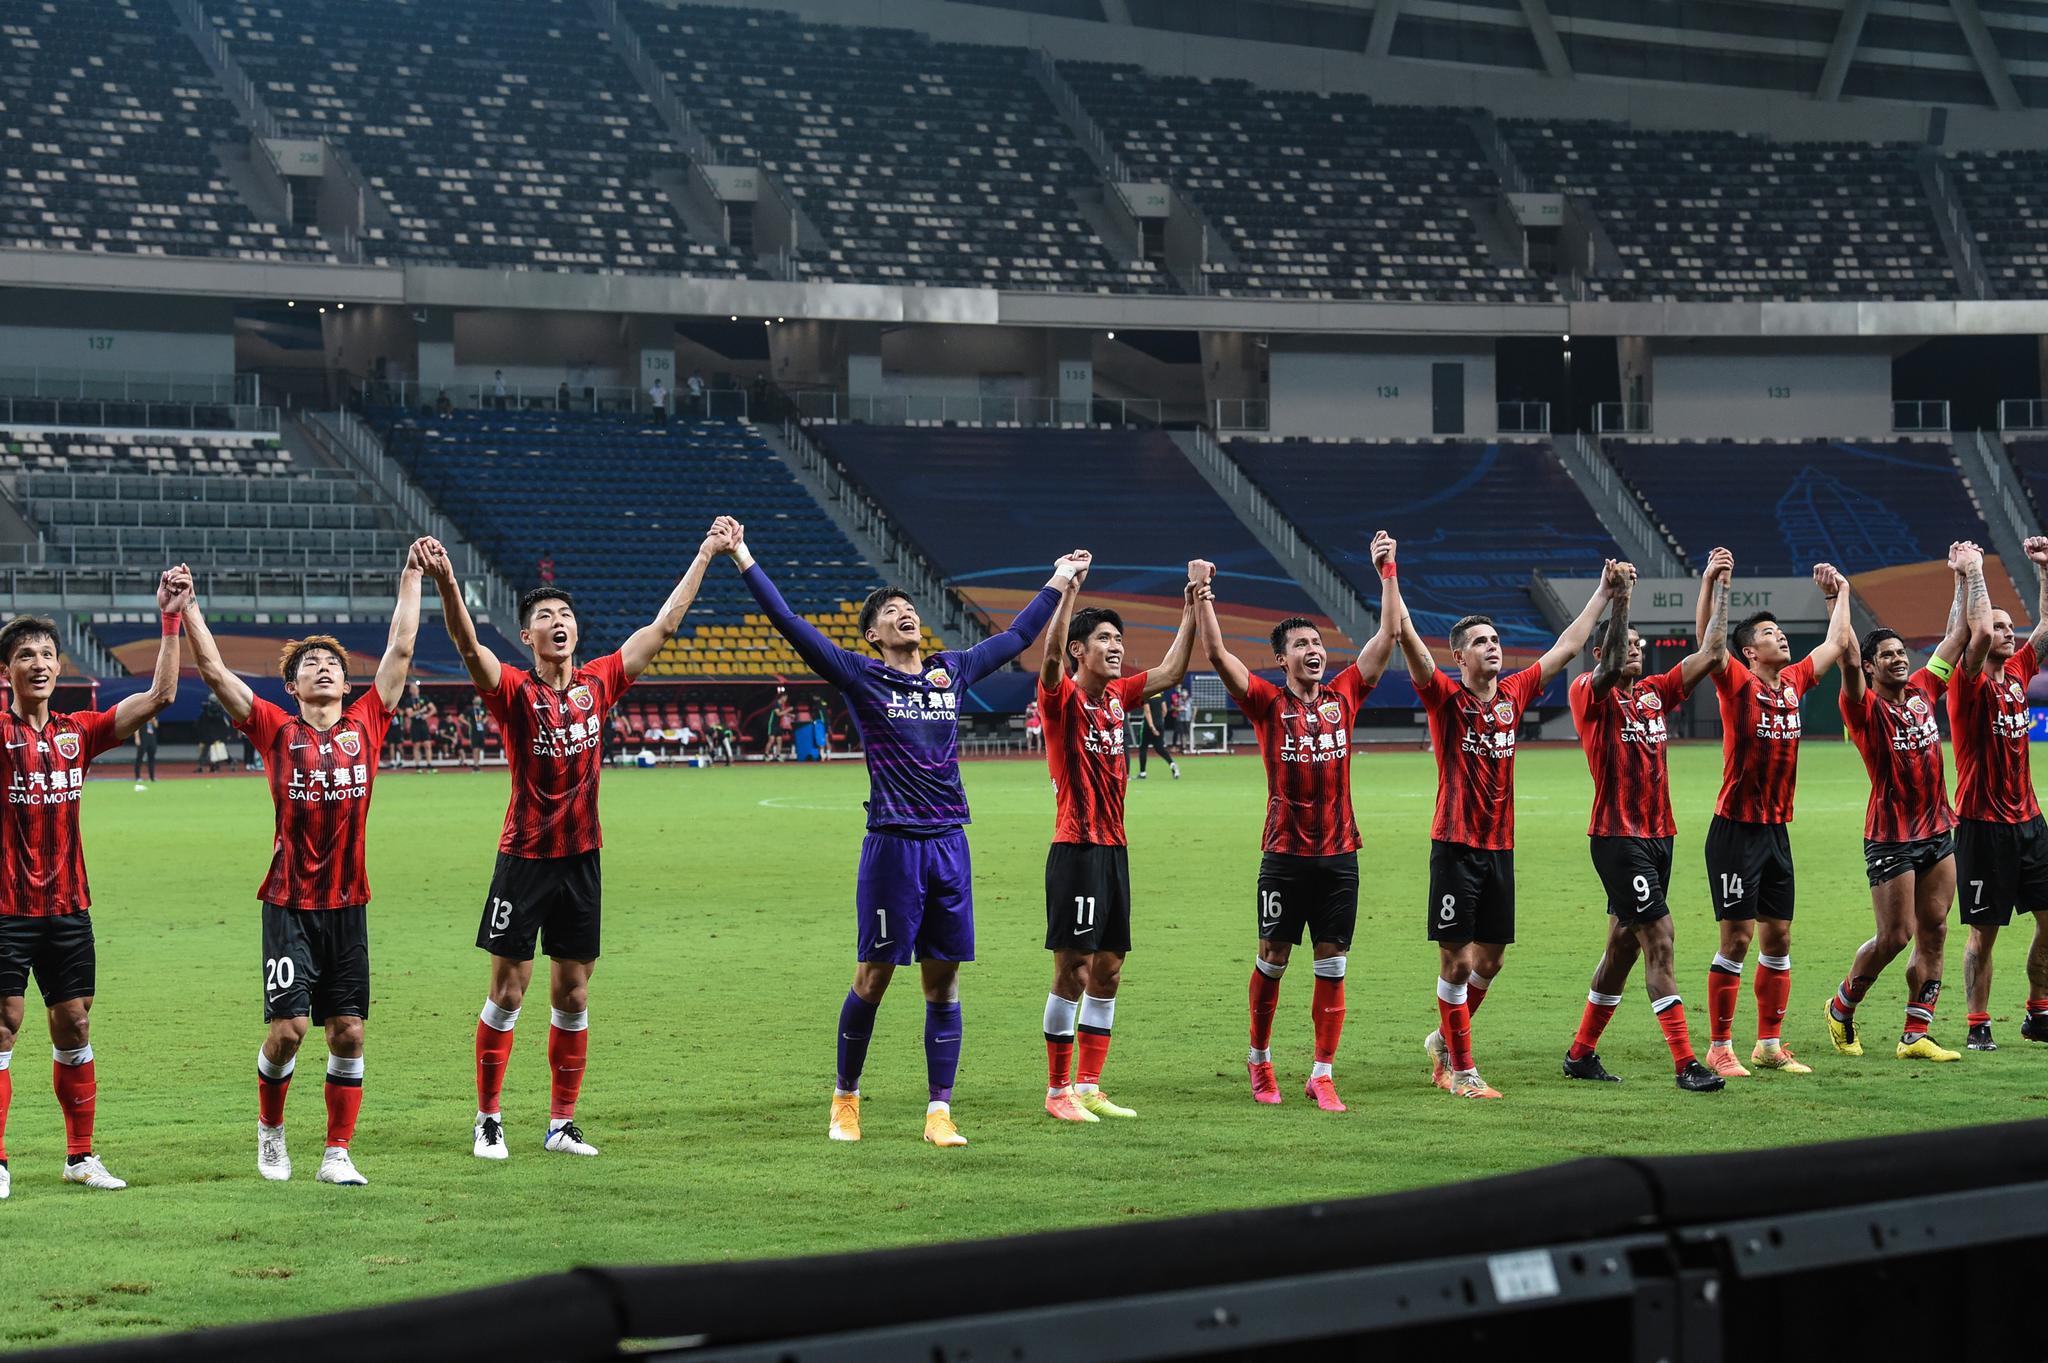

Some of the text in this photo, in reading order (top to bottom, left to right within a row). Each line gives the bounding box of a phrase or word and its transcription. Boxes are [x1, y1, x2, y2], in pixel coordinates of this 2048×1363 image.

[88, 336, 114, 351] 137
[647, 356, 670, 370] 136
[1065, 370, 1086, 380] 135
[1377, 385, 1399, 399] 134
[1768, 386, 1791, 399] 133
[1653, 592, 1772, 608] 出口 EXIT
[886, 690, 956, 709] 上汽集团
[887, 708, 957, 721] SAIC MOTOR
[1756, 712, 1801, 730] 上汽集
[532, 713, 600, 745] 上汽集团
[1756, 729, 1781, 740] SAIC
[1280, 728, 1347, 752] 上汽集团
[1621, 733, 1644, 743] SAI
[1893, 741, 1918, 751] SAIC
[532, 745, 562, 758] SAIC
[1280, 747, 1347, 763] SAIC MOTOR
[1461, 742, 1487, 757] SAIC
[8, 767, 83, 791] 上汽集团
[287, 764, 367, 788] 上汽集团
[8, 789, 82, 805] SAIC MOTOR
[288, 786, 367, 802] SAIC MOTOR
[1632, 875, 1650, 902] 9
[1720, 873, 1744, 899] 14
[1970, 880, 1984, 905] 7
[491, 896, 513, 930] 13
[1074, 896, 1096, 926] 11
[1261, 890, 1282, 919] 16
[1440, 894, 1455, 921] 8
[876, 909, 887, 939] 1
[266, 956, 295, 990] 20
